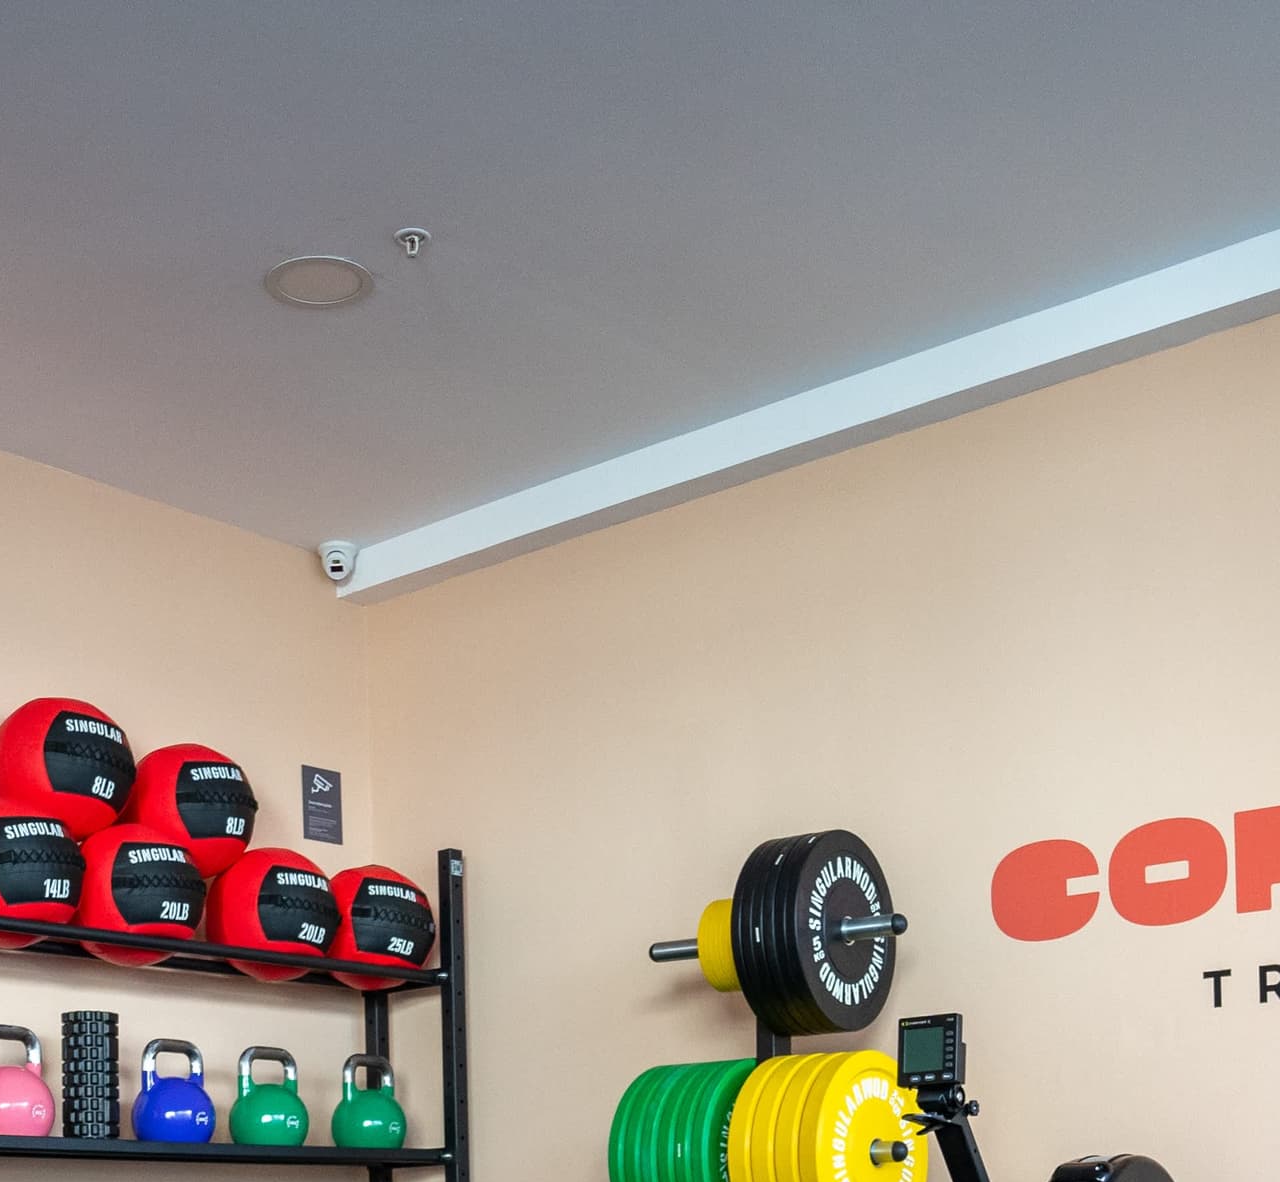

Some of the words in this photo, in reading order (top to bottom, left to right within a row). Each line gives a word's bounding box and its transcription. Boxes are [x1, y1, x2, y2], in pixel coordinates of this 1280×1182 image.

[92, 775, 115, 800] 8LB
[226, 817, 245, 836] 8LB
[44, 878, 70, 899] 14LB
[808, 856, 877, 931] SINGULARWOD
[160, 901, 190, 921] 20LB
[298, 922, 326, 944] 20LB
[387, 936, 414, 956] 25LB
[812, 936, 822, 951] 5
[813, 950, 825, 962] KG
